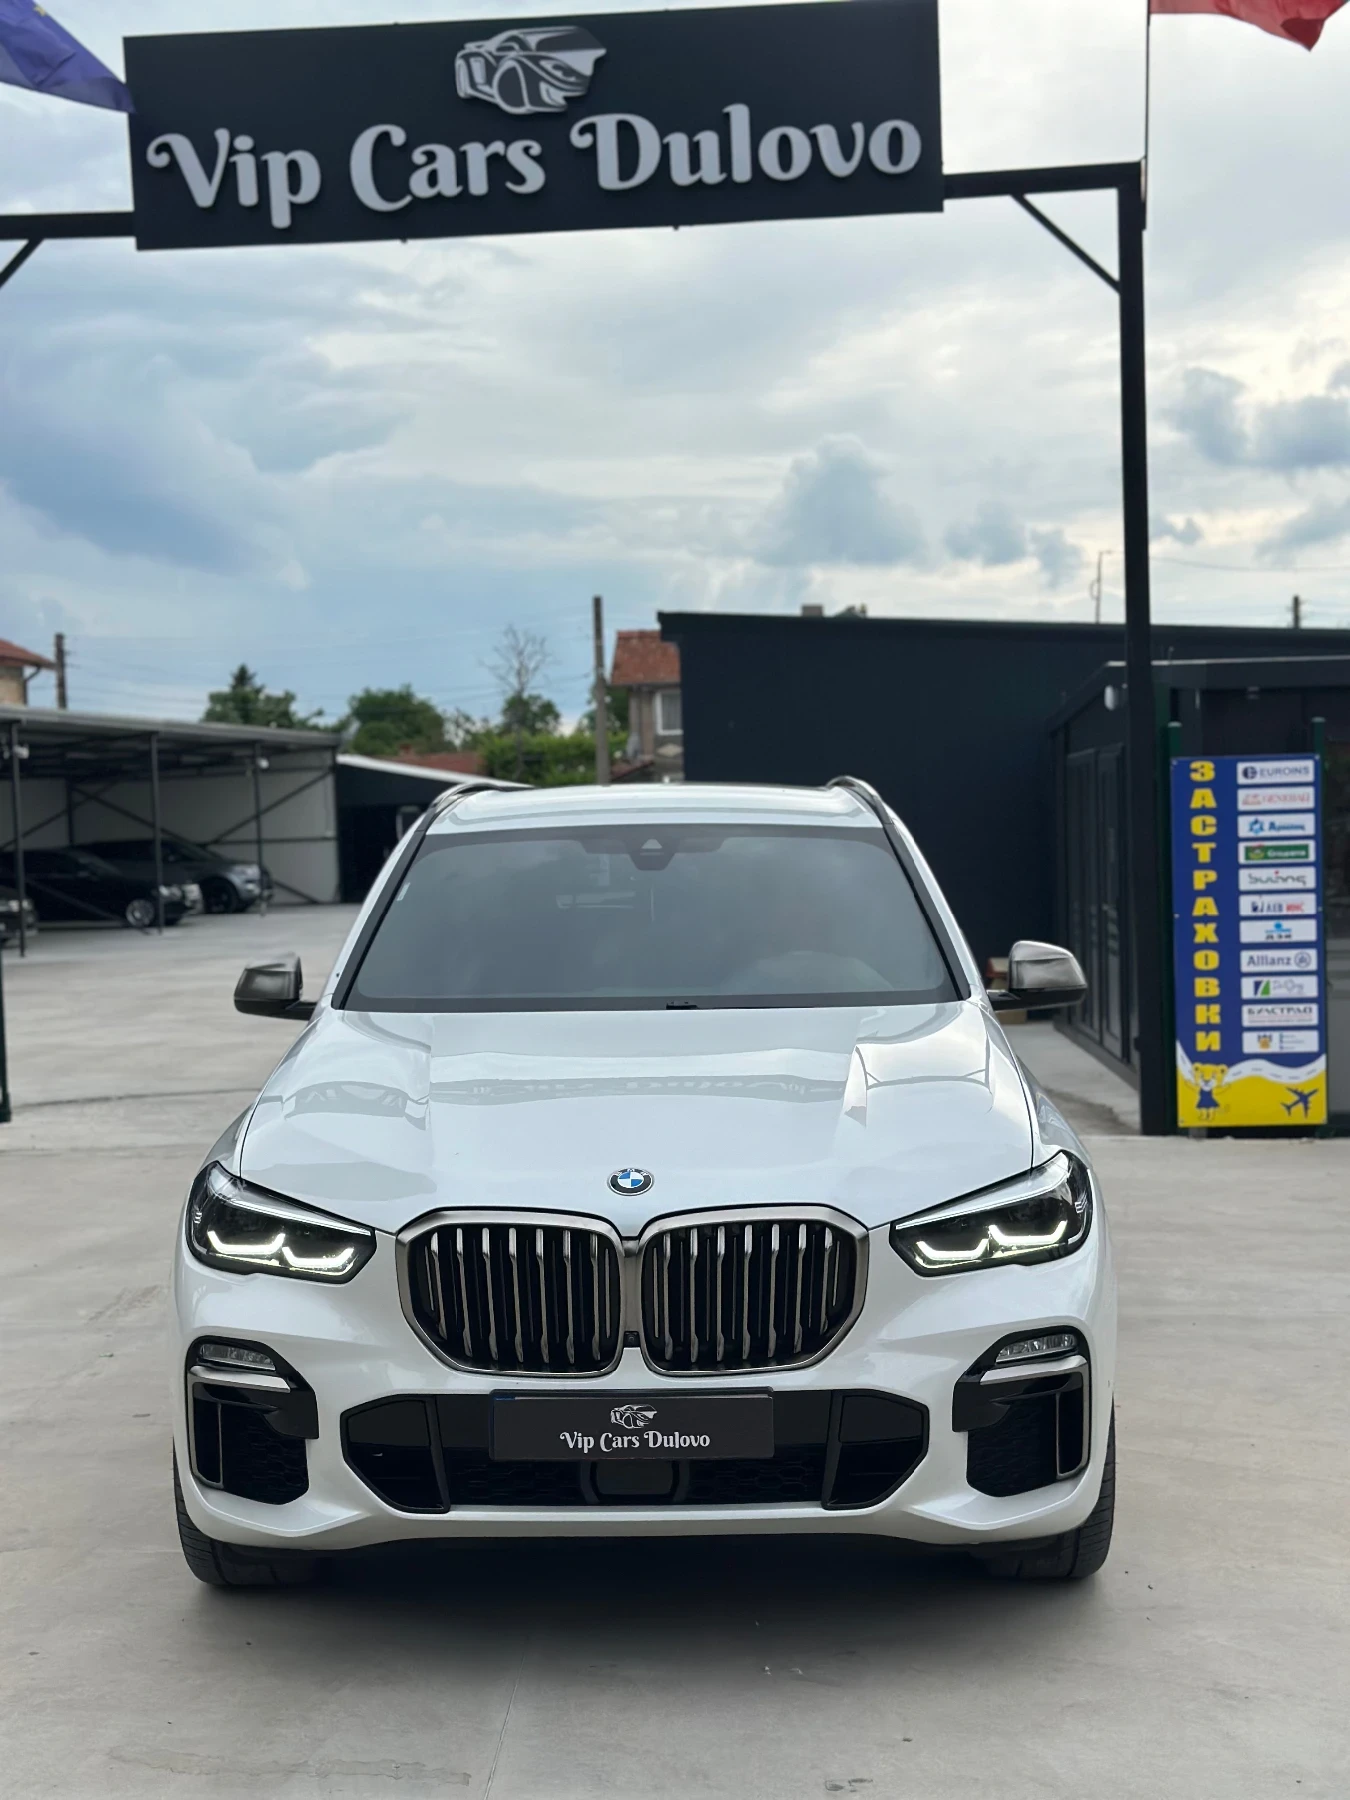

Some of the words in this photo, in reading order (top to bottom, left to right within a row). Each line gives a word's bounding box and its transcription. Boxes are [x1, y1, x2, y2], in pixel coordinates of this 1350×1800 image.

[147, 129, 321, 228] Vip
[350, 124, 546, 211] Cars
[570, 104, 922, 190] Dulovo
[1260, 766, 1310, 777] EUROINS
[1190, 760, 1222, 1052] ЗАСТРАХОВКИ
[1247, 953, 1292, 967] Allianz
[559, 1431, 595, 1454] Vip
[599, 1432, 640, 1453] Cars
[643, 1430, 711, 1449] Dulovo
